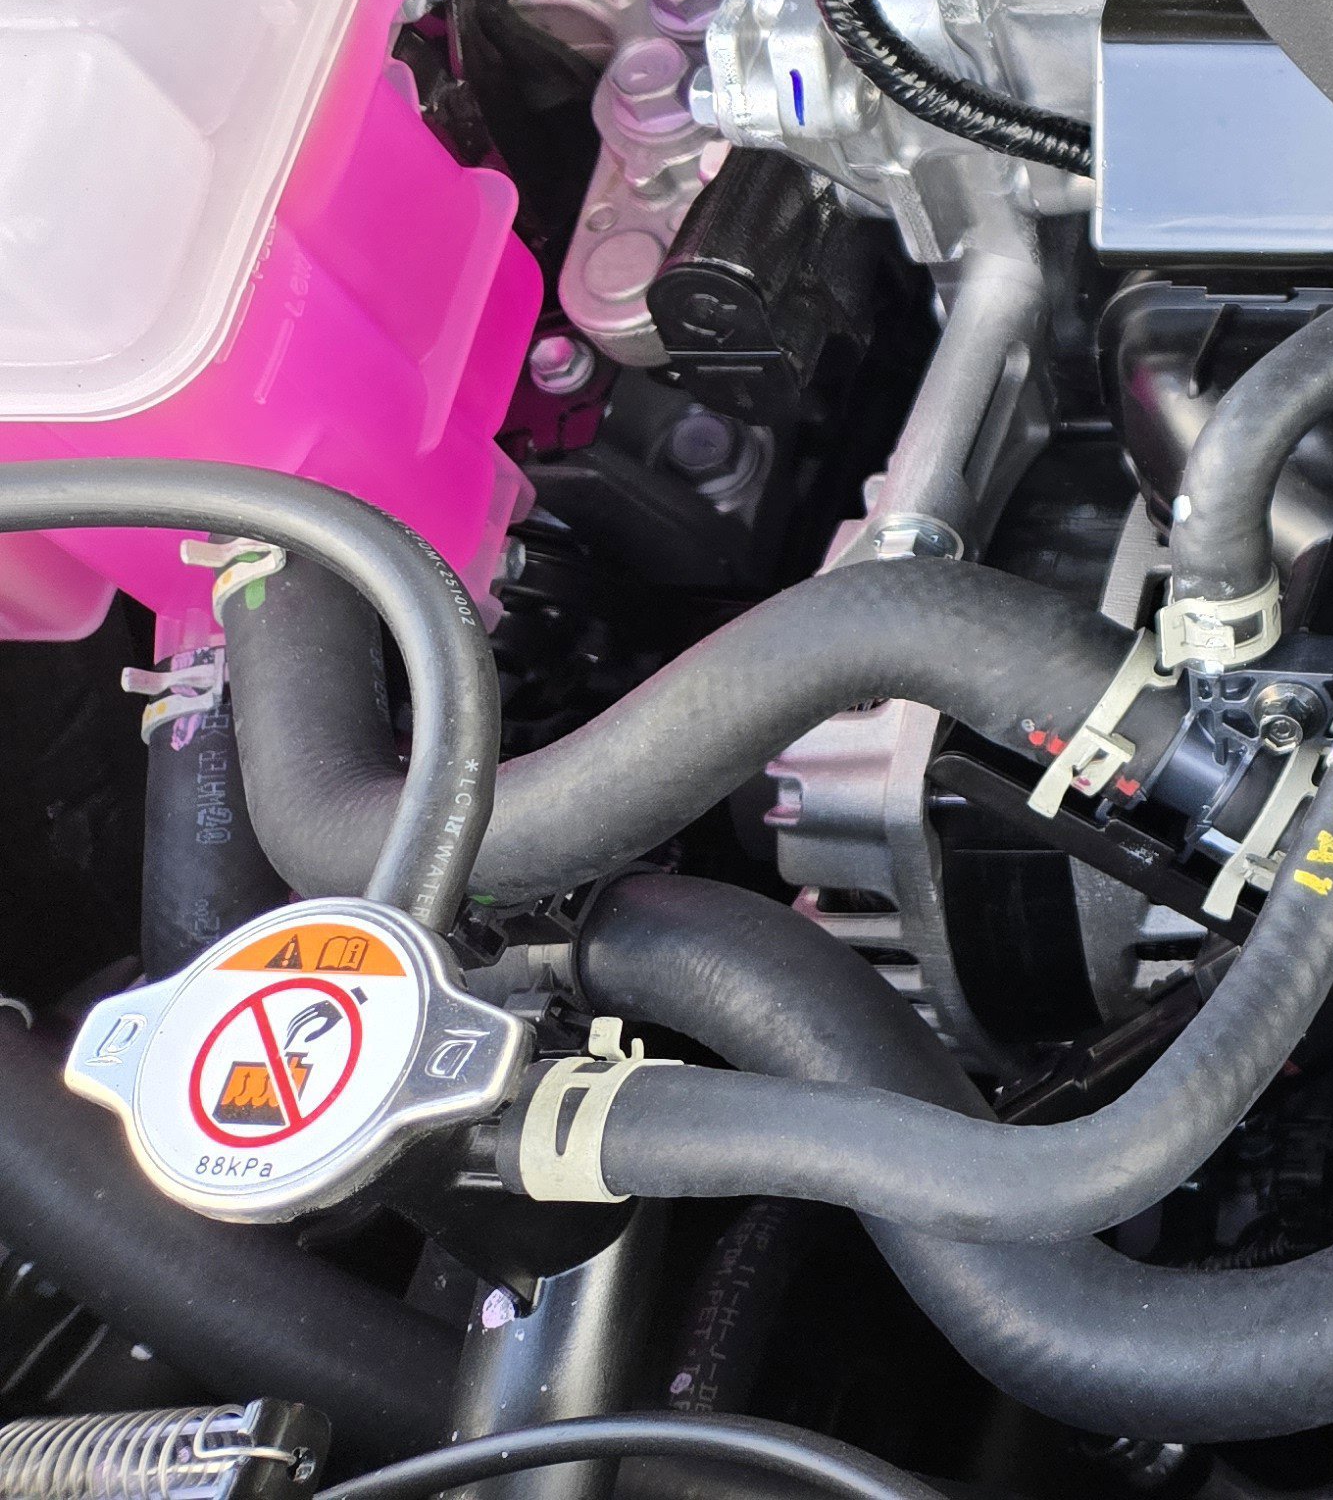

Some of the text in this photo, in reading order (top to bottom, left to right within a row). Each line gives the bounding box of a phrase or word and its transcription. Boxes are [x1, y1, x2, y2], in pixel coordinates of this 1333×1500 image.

[440, 570, 476, 626] 251002
[412, 844, 454, 921] WATER
[193, 1155, 274, 1179] 88kPa
